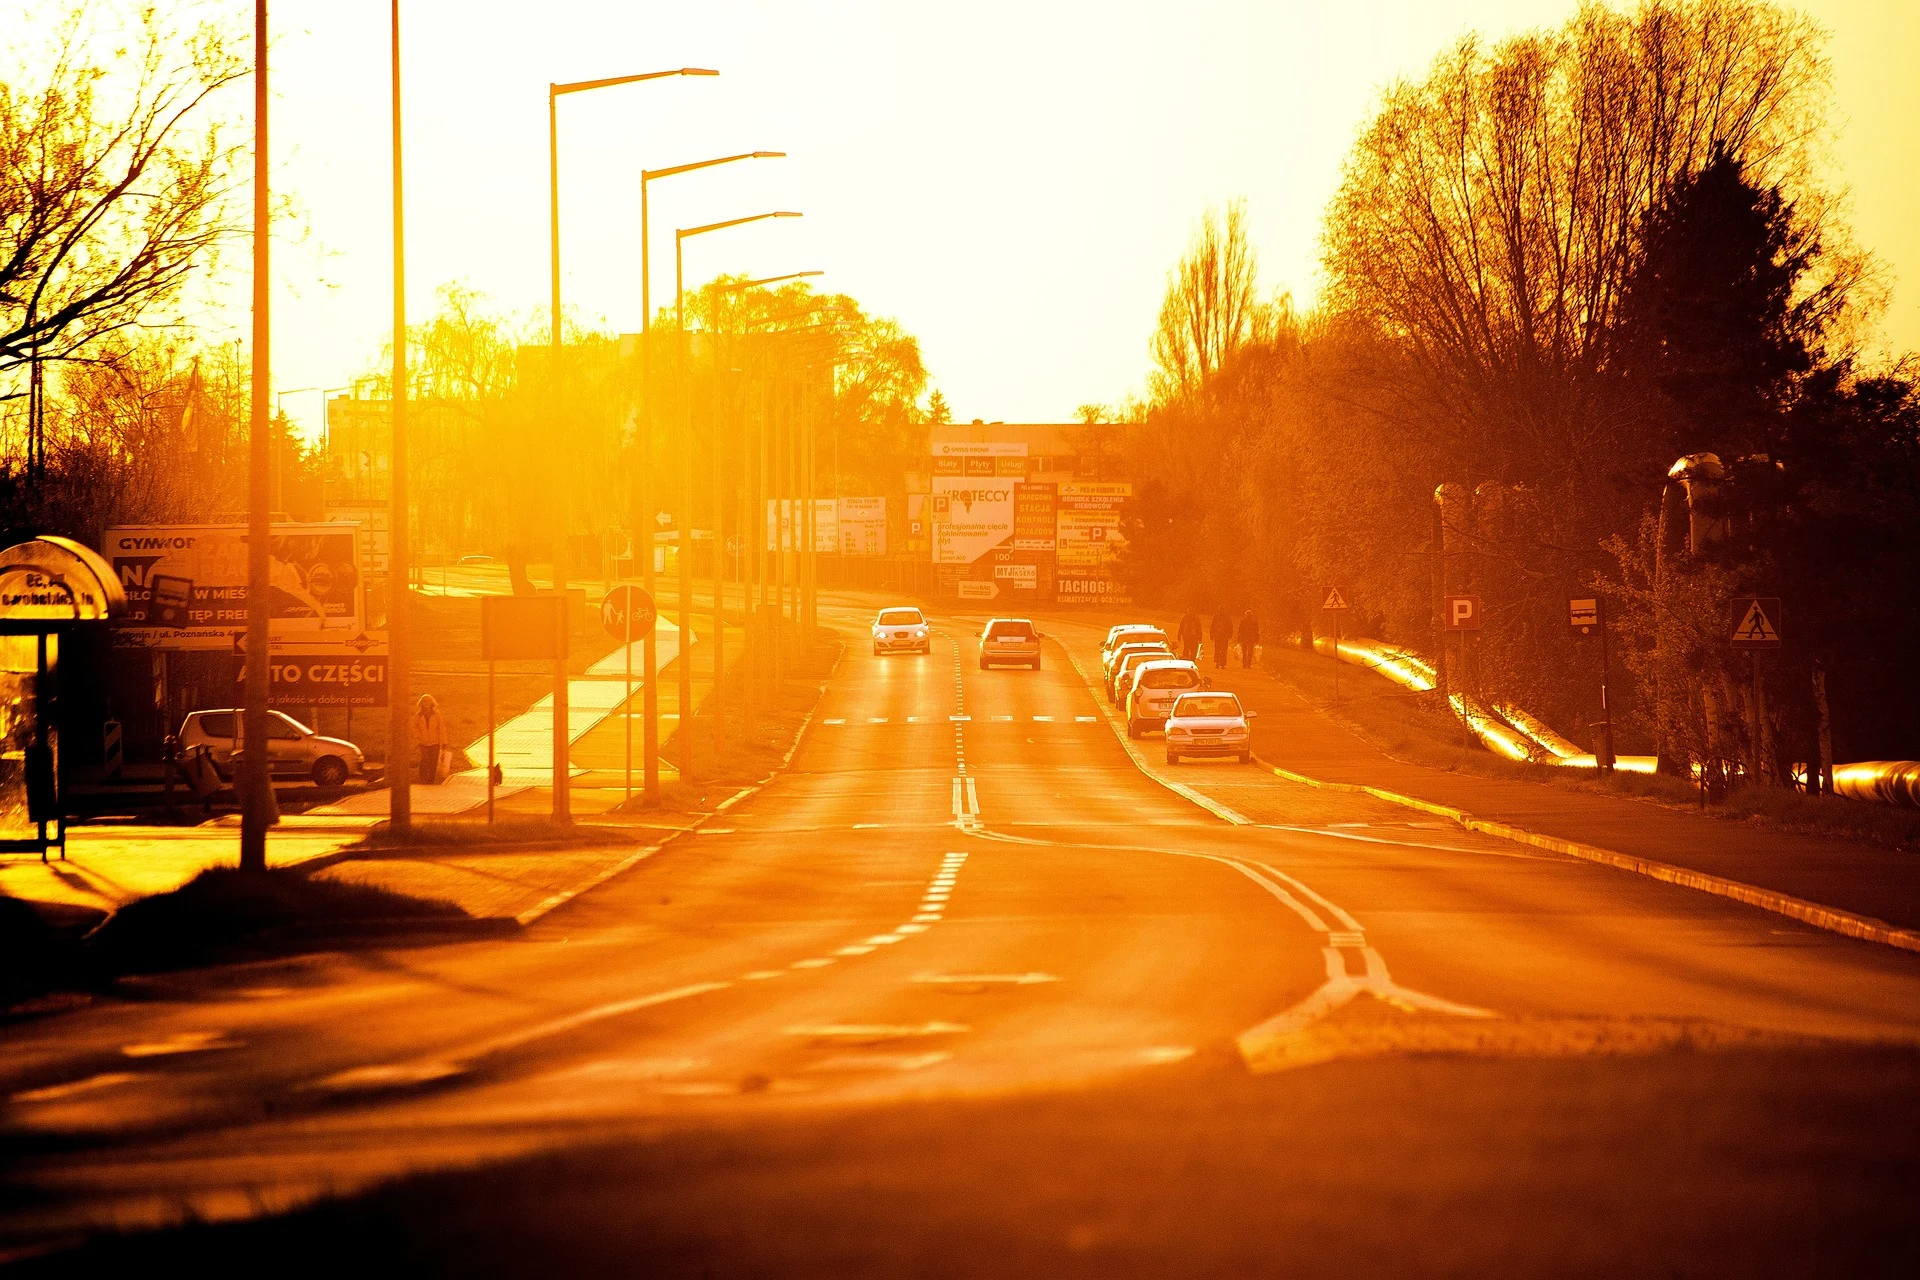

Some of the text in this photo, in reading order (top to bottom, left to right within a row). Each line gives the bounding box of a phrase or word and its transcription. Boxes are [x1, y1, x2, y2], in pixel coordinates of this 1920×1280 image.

[938, 460, 958, 469] Blaty
[970, 460, 991, 469] Płyty
[1001, 460, 1024, 469] Usługi
[937, 498, 946, 511] P
[1019, 504, 1051, 513] STACJA
[1016, 516, 1055, 524] KONTROLI
[912, 522, 920, 534] P
[937, 524, 1009, 534] profesjonalne cięcie
[1015, 527, 1054, 536] POJAZDÓW
[942, 530, 988, 538] okleinowanie
[1093, 528, 1102, 540] P
[995, 553, 1010, 561] 100
[194, 589, 209, 600] W
[213, 587, 247, 600] MIEŚ
[1452, 600, 1472, 626] P
[174, 629, 225, 638] Poznańska
[308, 659, 384, 687] CZĘŚCI
[275, 693, 306, 706] jakość
[318, 693, 349, 707] dobrej
[350, 694, 375, 703] cenie
